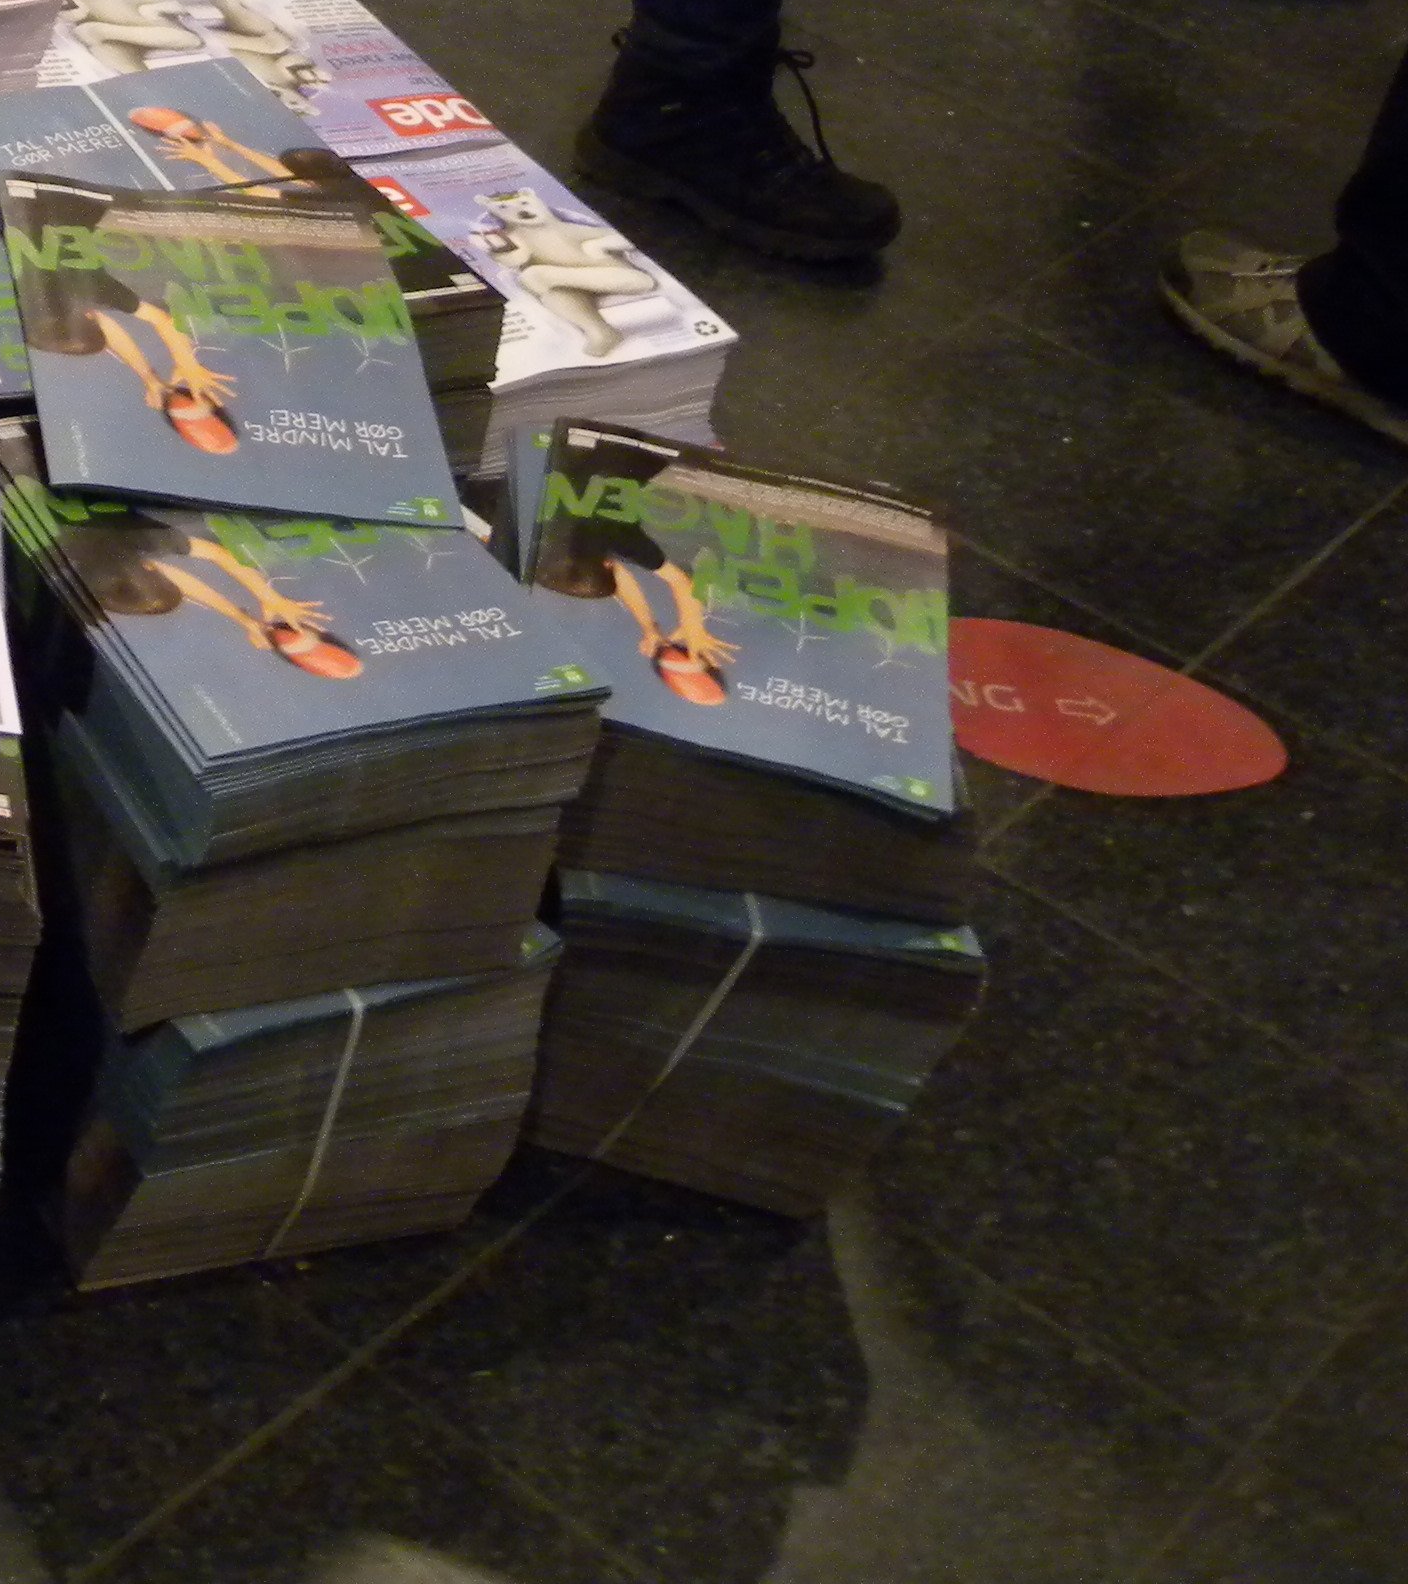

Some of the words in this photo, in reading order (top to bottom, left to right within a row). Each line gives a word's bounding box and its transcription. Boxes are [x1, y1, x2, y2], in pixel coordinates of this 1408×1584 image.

[267, 408, 346, 433] MERE!
[353, 420, 402, 438] GØR
[244, 420, 350, 451] MINDRE,
[355, 436, 407, 457] TAL
[372, 613, 449, 633] MERE!
[457, 605, 506, 625] GØR
[354, 630, 466, 655] MINDRE,
[467, 618, 521, 643] TAL
[736, 682, 849, 726] MINDRE,
[765, 676, 848, 712] MERE!
[855, 704, 908, 728] GØR
[865, 719, 908, 743] TAL
